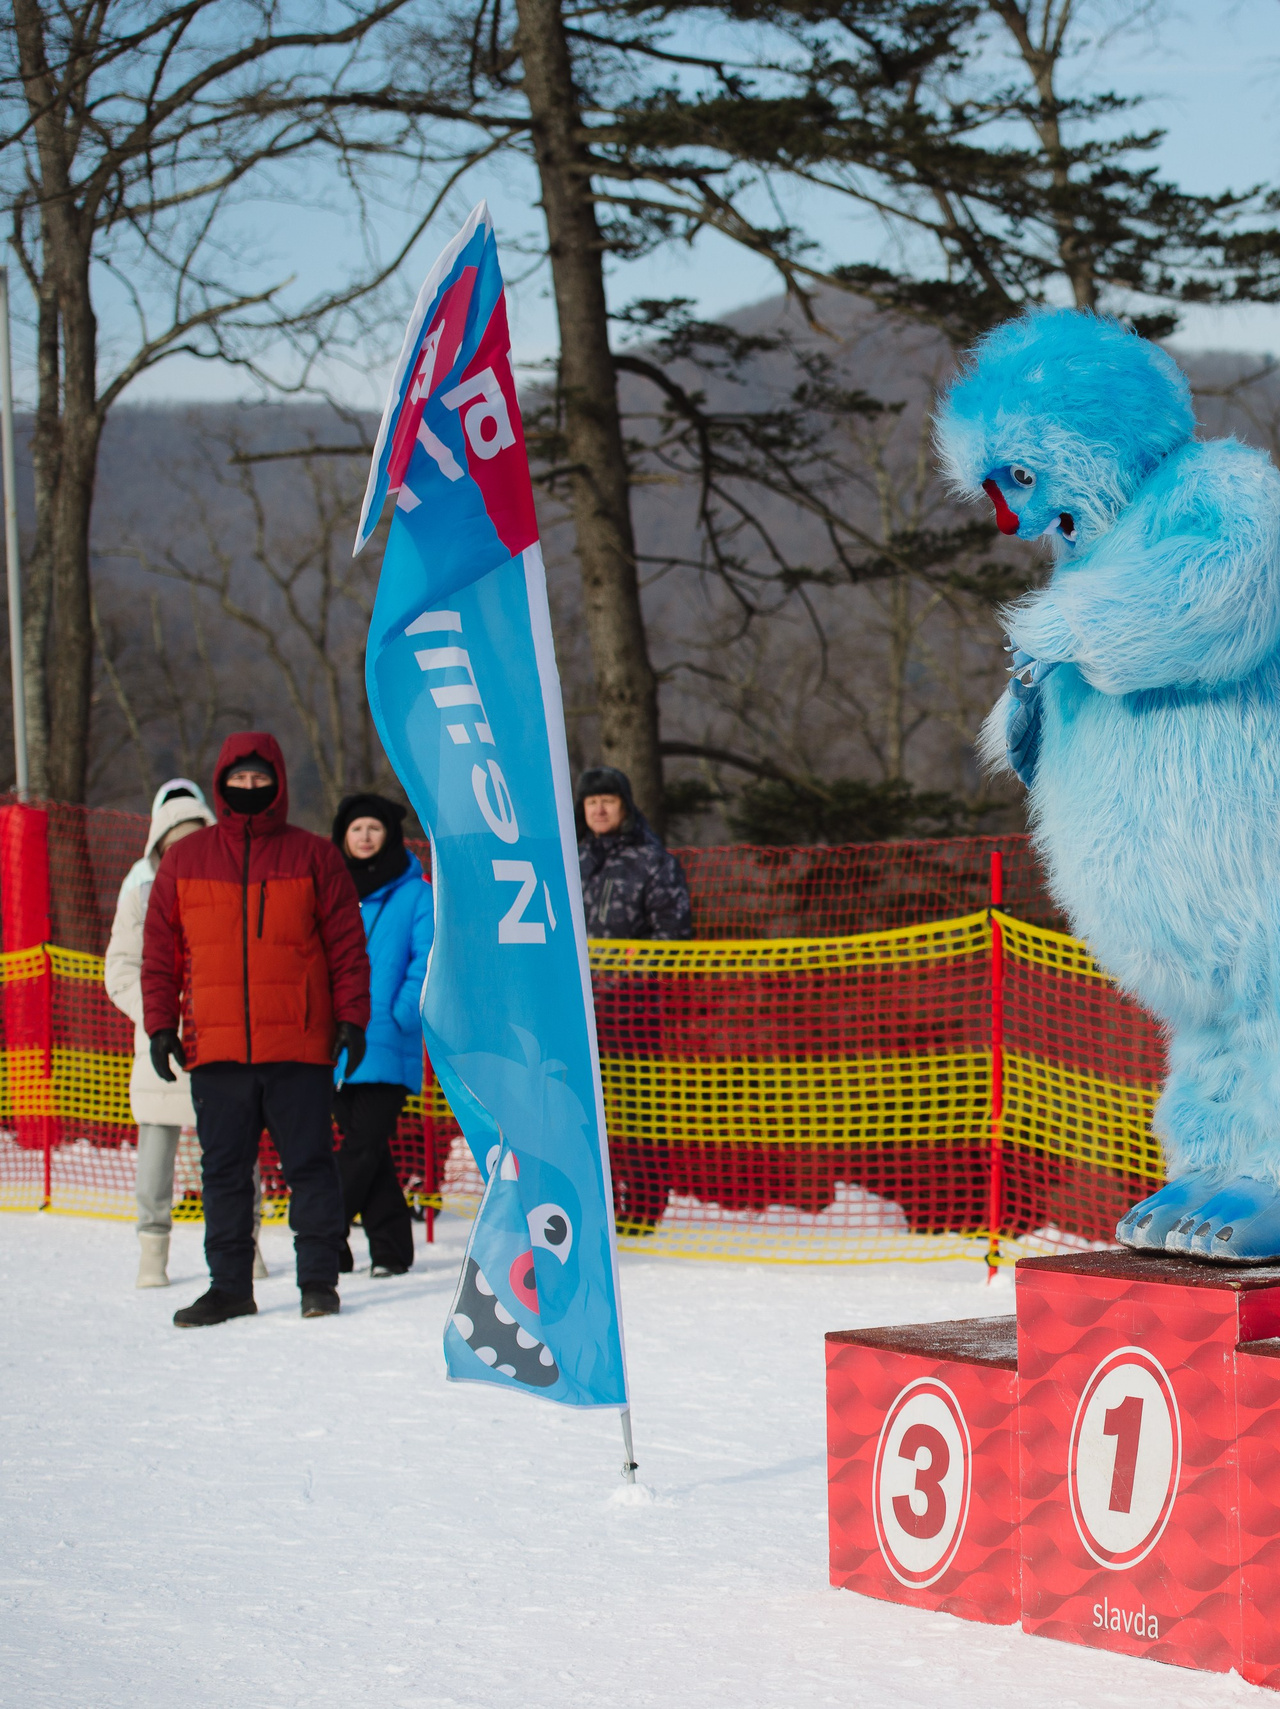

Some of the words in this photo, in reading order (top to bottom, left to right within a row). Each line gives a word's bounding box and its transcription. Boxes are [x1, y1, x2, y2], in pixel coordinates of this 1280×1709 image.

[891, 1423, 951, 1540] 3
[1102, 1395, 1143, 1515] 1
[1092, 1596, 1159, 1639] slavda
